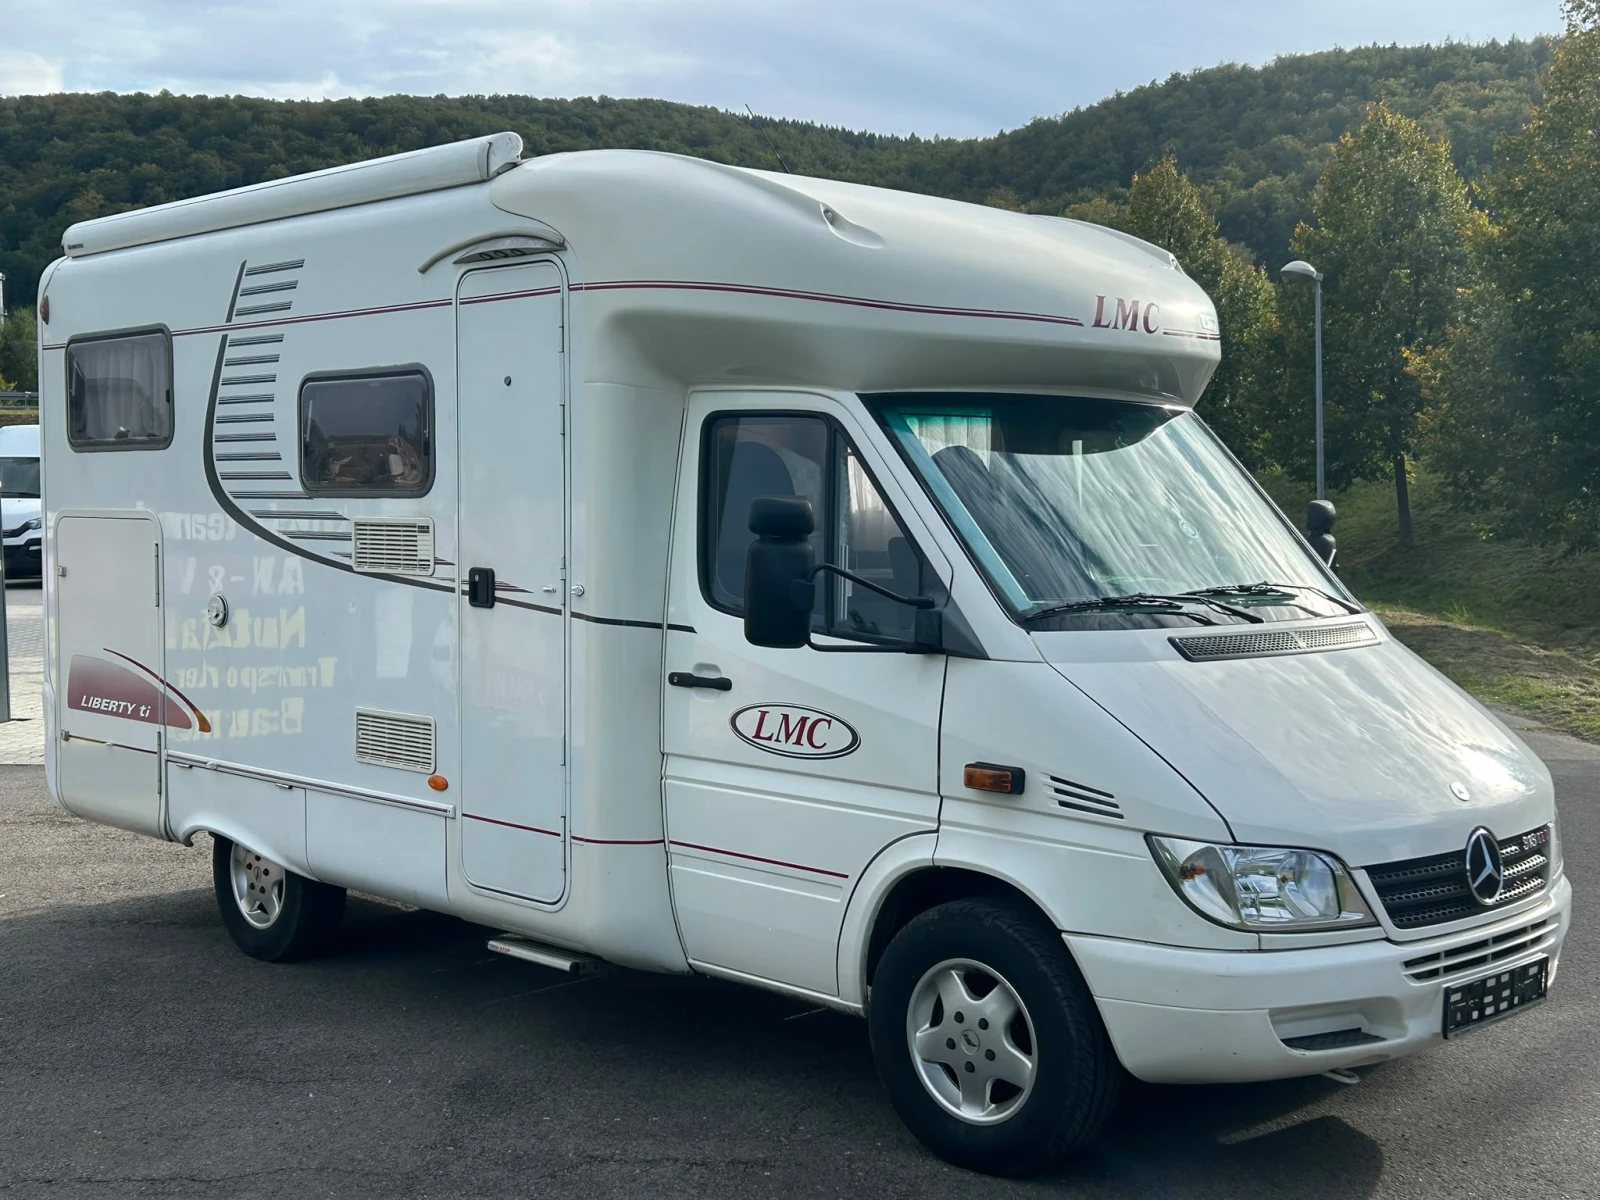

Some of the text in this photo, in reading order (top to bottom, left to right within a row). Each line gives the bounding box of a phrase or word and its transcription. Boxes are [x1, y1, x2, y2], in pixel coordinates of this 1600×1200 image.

[1091, 294, 1160, 334] LMC
[80, 695, 152, 718] LIBERTY ti
[752, 709, 832, 750] LMC
